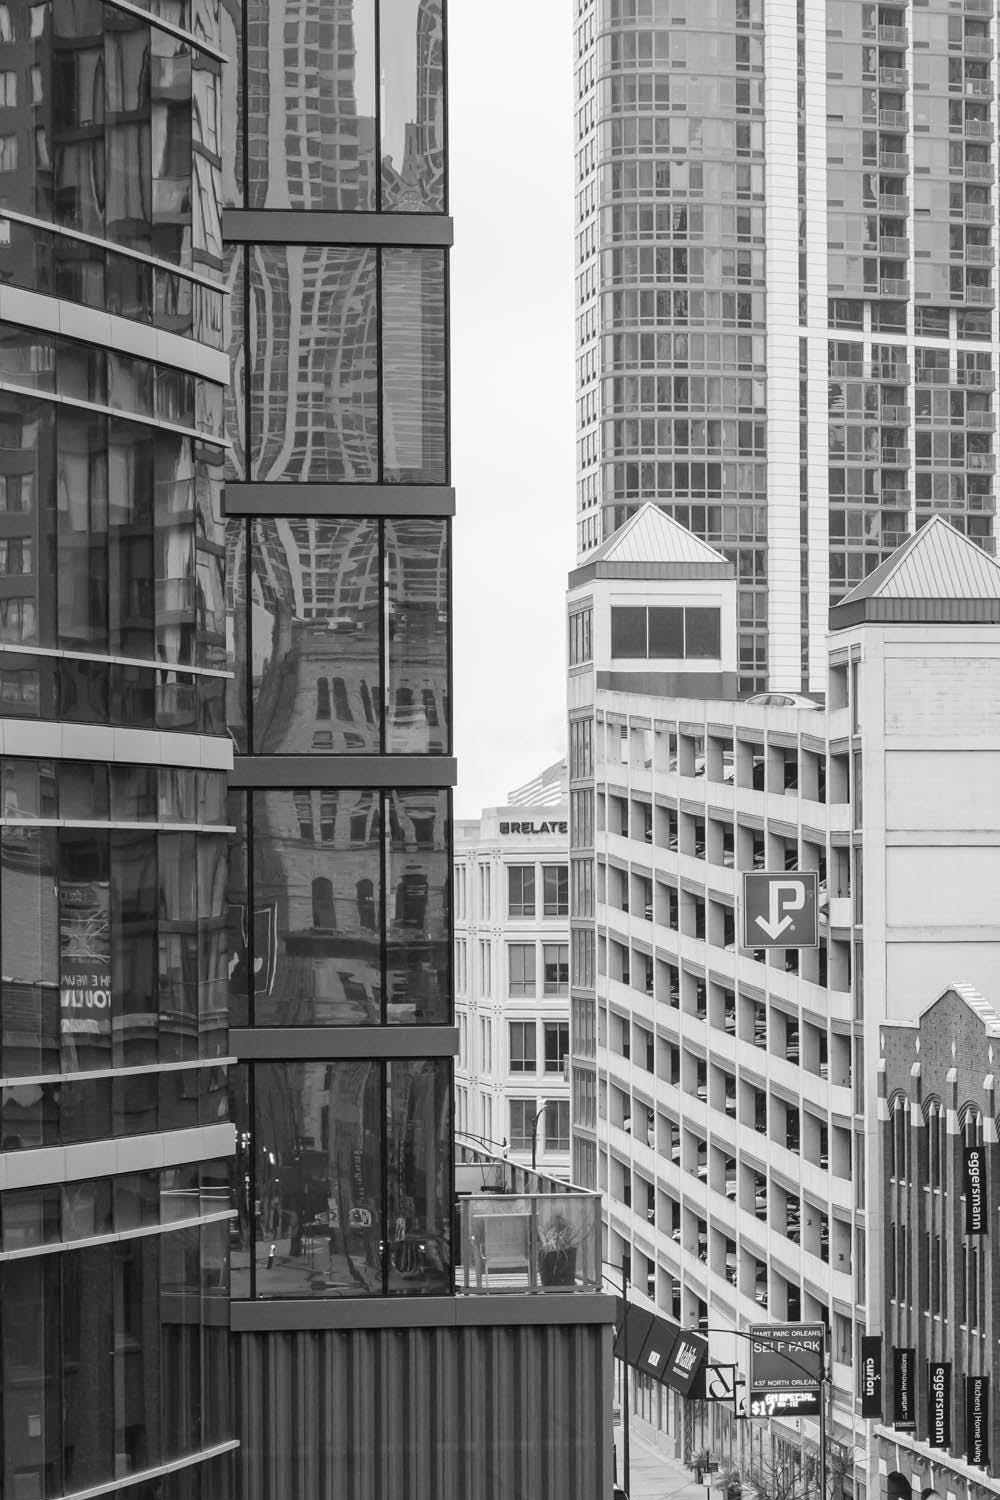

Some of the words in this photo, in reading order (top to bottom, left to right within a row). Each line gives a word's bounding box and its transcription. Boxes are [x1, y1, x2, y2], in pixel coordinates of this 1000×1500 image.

[968, 1152, 981, 1230] eggersmann
[753, 1341, 785, 1353] SELF
[788, 1340, 820, 1353] PARK
[866, 1358, 878, 1396] curion
[751, 1401, 775, 1416] $17
[933, 1368, 944, 1443] eggersmann
[974, 1379, 982, 1411] Kitchens
[974, 1415, 982, 1439] Home
[973, 1440, 982, 1463] Living
